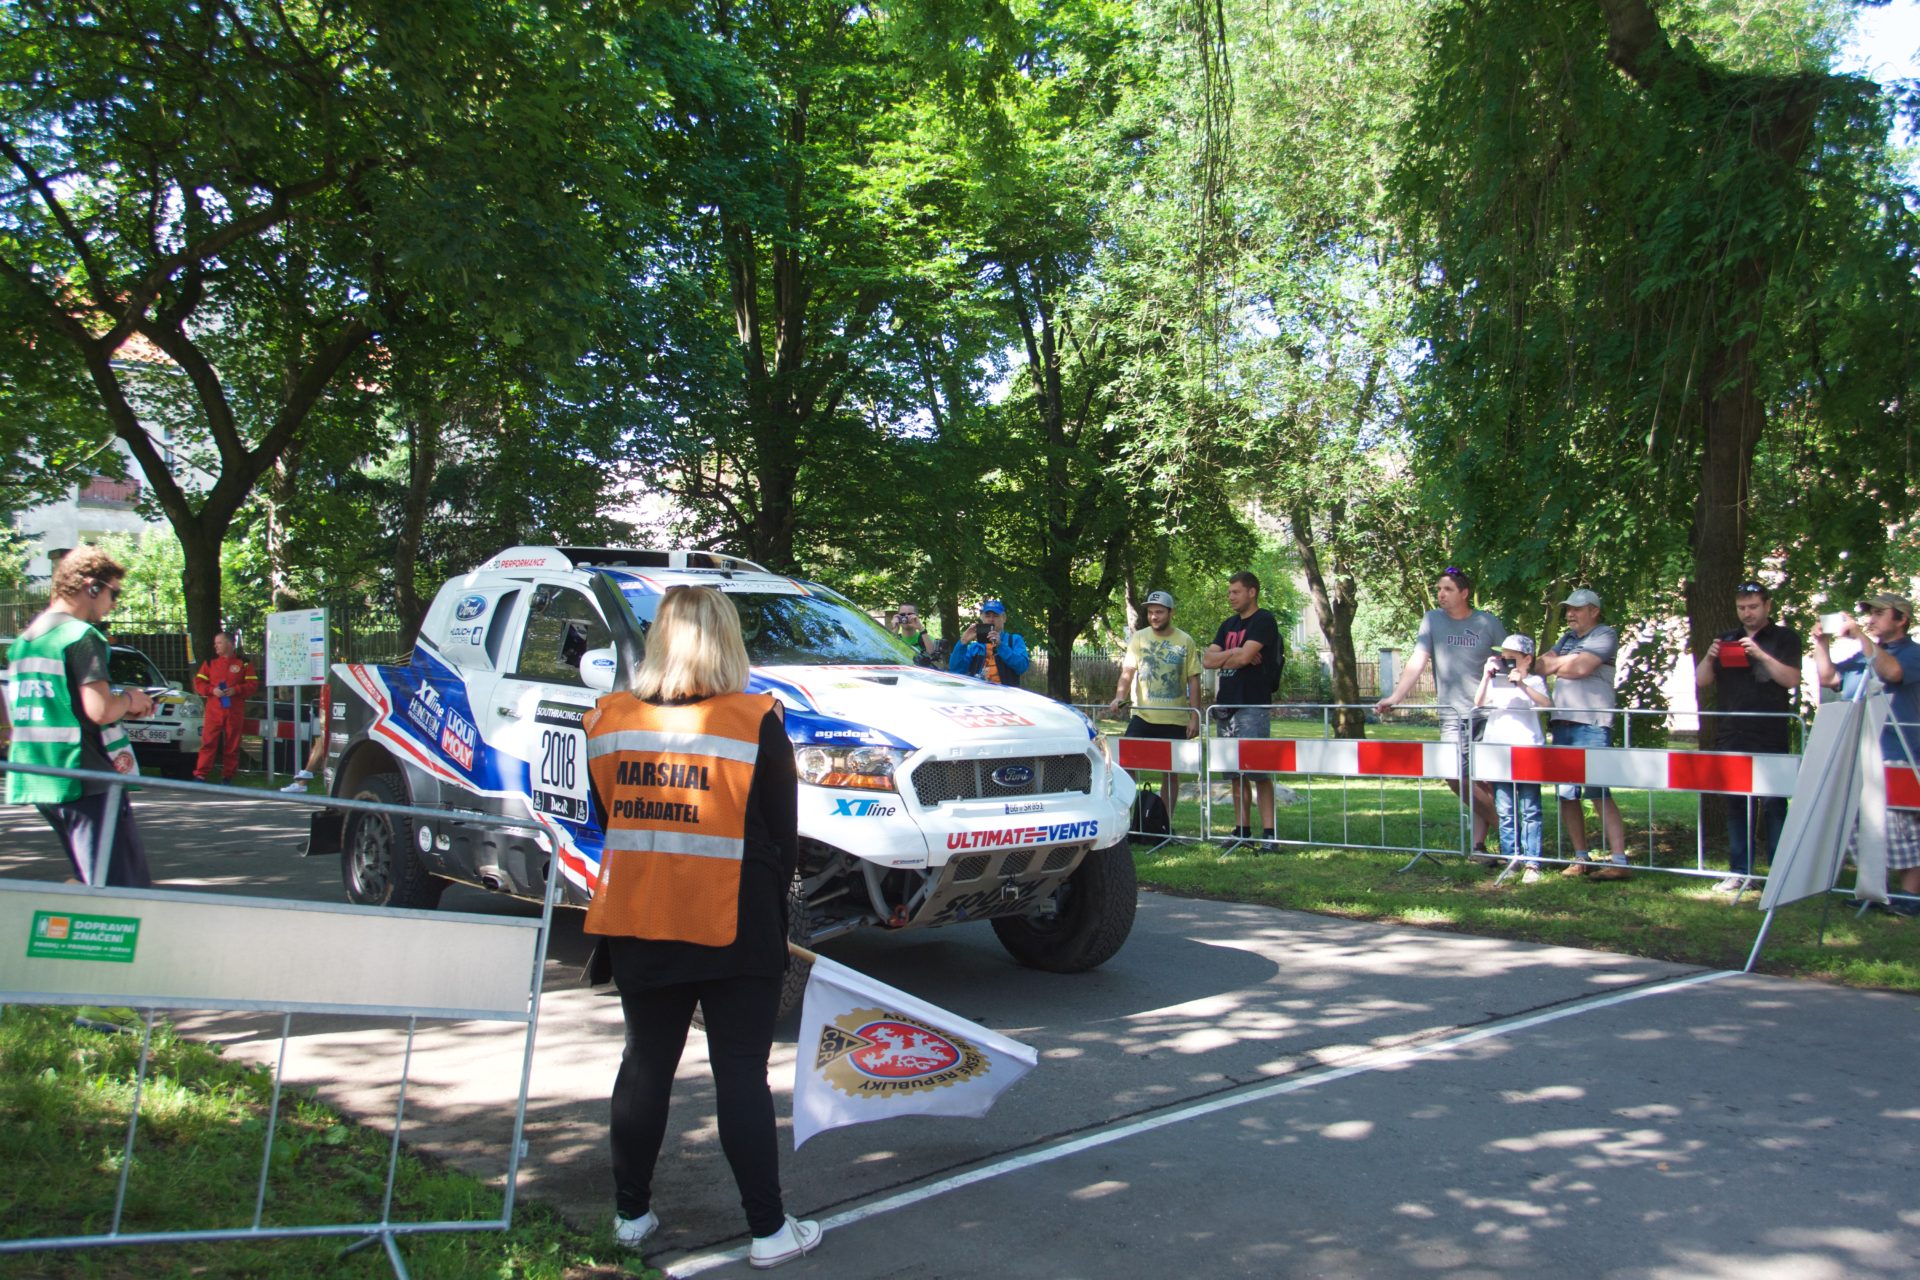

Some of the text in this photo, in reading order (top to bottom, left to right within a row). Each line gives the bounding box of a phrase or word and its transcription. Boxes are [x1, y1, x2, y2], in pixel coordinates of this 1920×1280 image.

[501, 558, 546, 569] PERFORMANCE
[459, 598, 481, 618] Ford
[1447, 635, 1476, 647] PUMA
[414, 680, 445, 717] XTline
[447, 710, 475, 748] LIQUI
[444, 729, 472, 767] MOLY
[541, 730, 576, 790] 2018
[616, 761, 710, 791] MARSHAL
[1005, 767, 1029, 781] Ford
[613, 797, 699, 823] POŘADATEL
[830, 799, 896, 816] XTline
[72, 931, 124, 943] ZNAČENÍ
[74, 921, 136, 933] DOPRAVNÍ
[858, 1071, 960, 1091] REPUBLIKY
